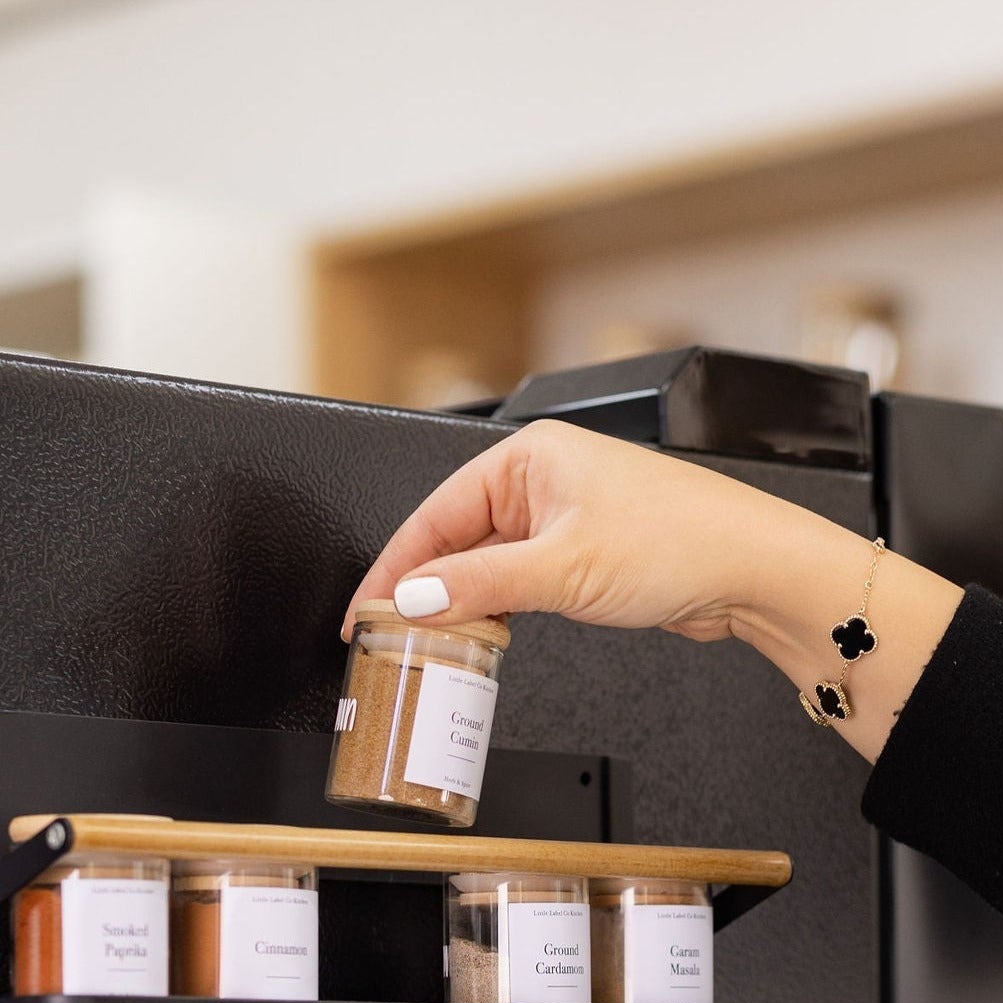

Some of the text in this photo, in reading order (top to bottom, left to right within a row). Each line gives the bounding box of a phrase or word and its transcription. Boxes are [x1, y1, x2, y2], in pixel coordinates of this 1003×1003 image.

[451, 711, 484, 732] Ground
[450, 730, 479, 750] Cumin
[102, 922, 149, 937] Smoked
[105, 943, 147, 961] Paprika
[255, 940, 308, 956] Cinnamon
[544, 942, 579, 956] Ground
[670, 944, 700, 958] Garam
[670, 962, 700, 976] Masala
